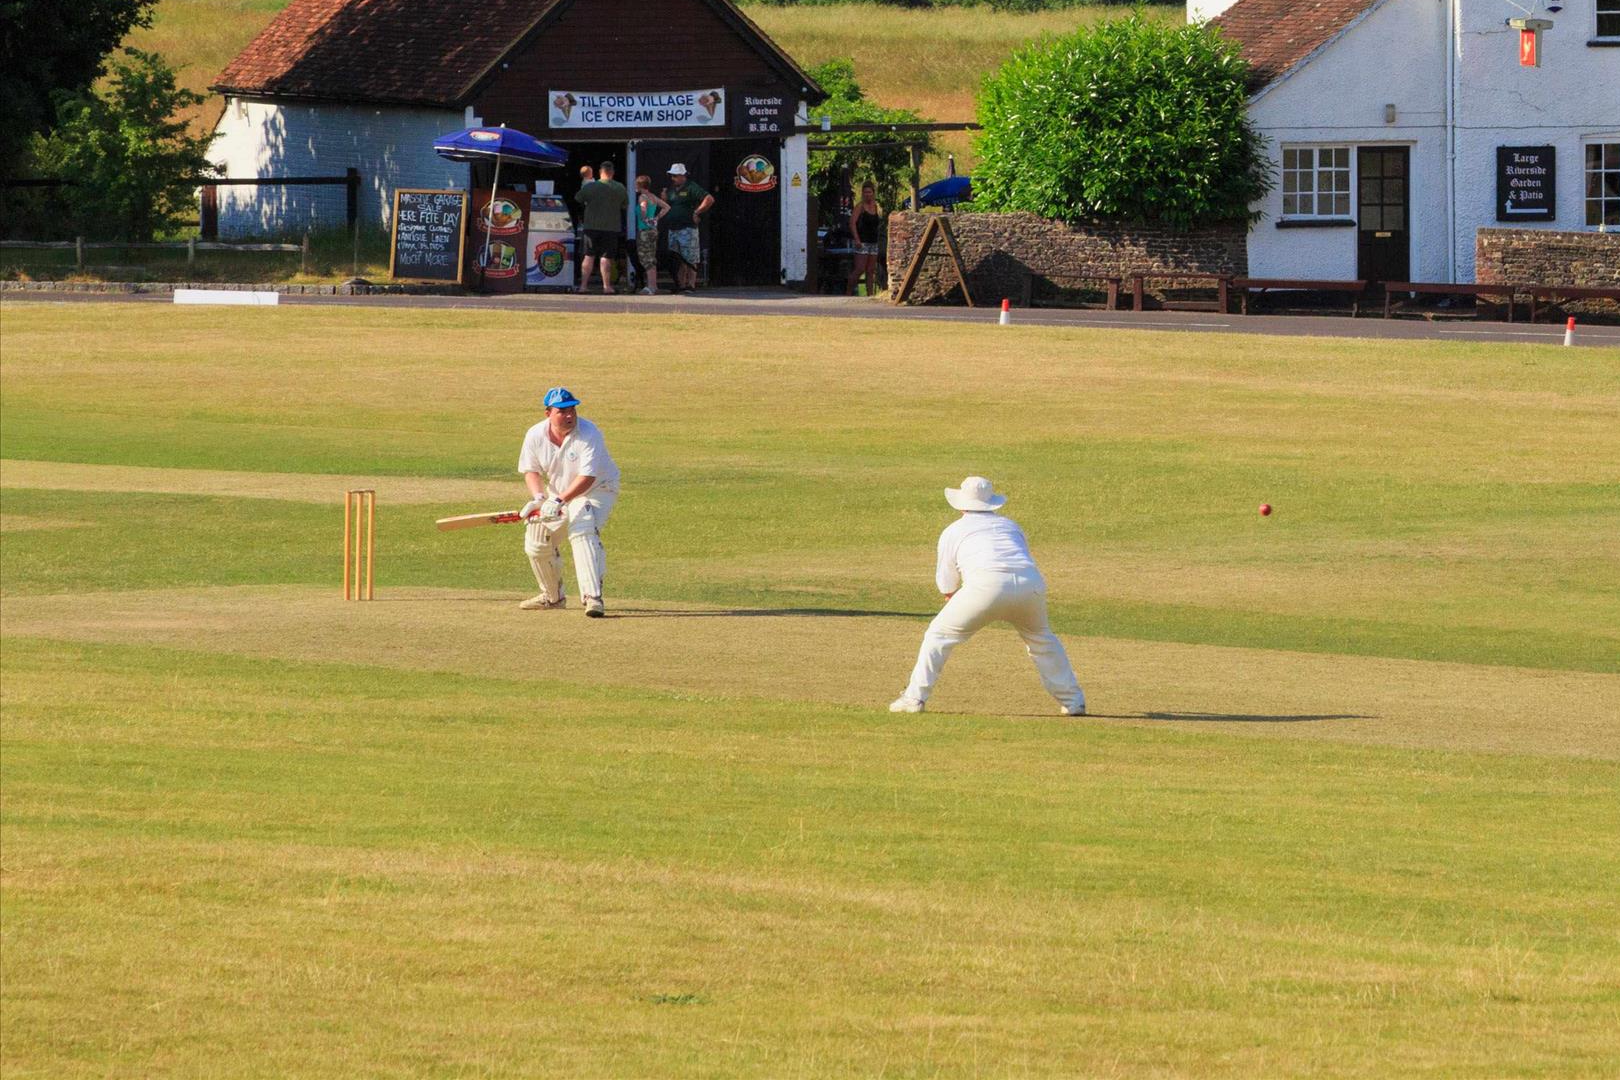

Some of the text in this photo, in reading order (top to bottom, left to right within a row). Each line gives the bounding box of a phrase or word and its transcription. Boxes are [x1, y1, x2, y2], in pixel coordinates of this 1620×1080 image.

[580, 94, 694, 107] TILFORD VILLAGE
[744, 97, 782, 106] Riverside
[581, 109, 693, 122] ICE CREAM SHOP
[749, 107, 778, 116] Garden
[1513, 153, 1539, 164] Large
[1505, 166, 1547, 175] Riverside
[1510, 178, 1542, 188] Garden
[1508, 190, 1544, 201] & Patio
[417, 204, 442, 213] SALE
[443, 212, 460, 228] DAY
